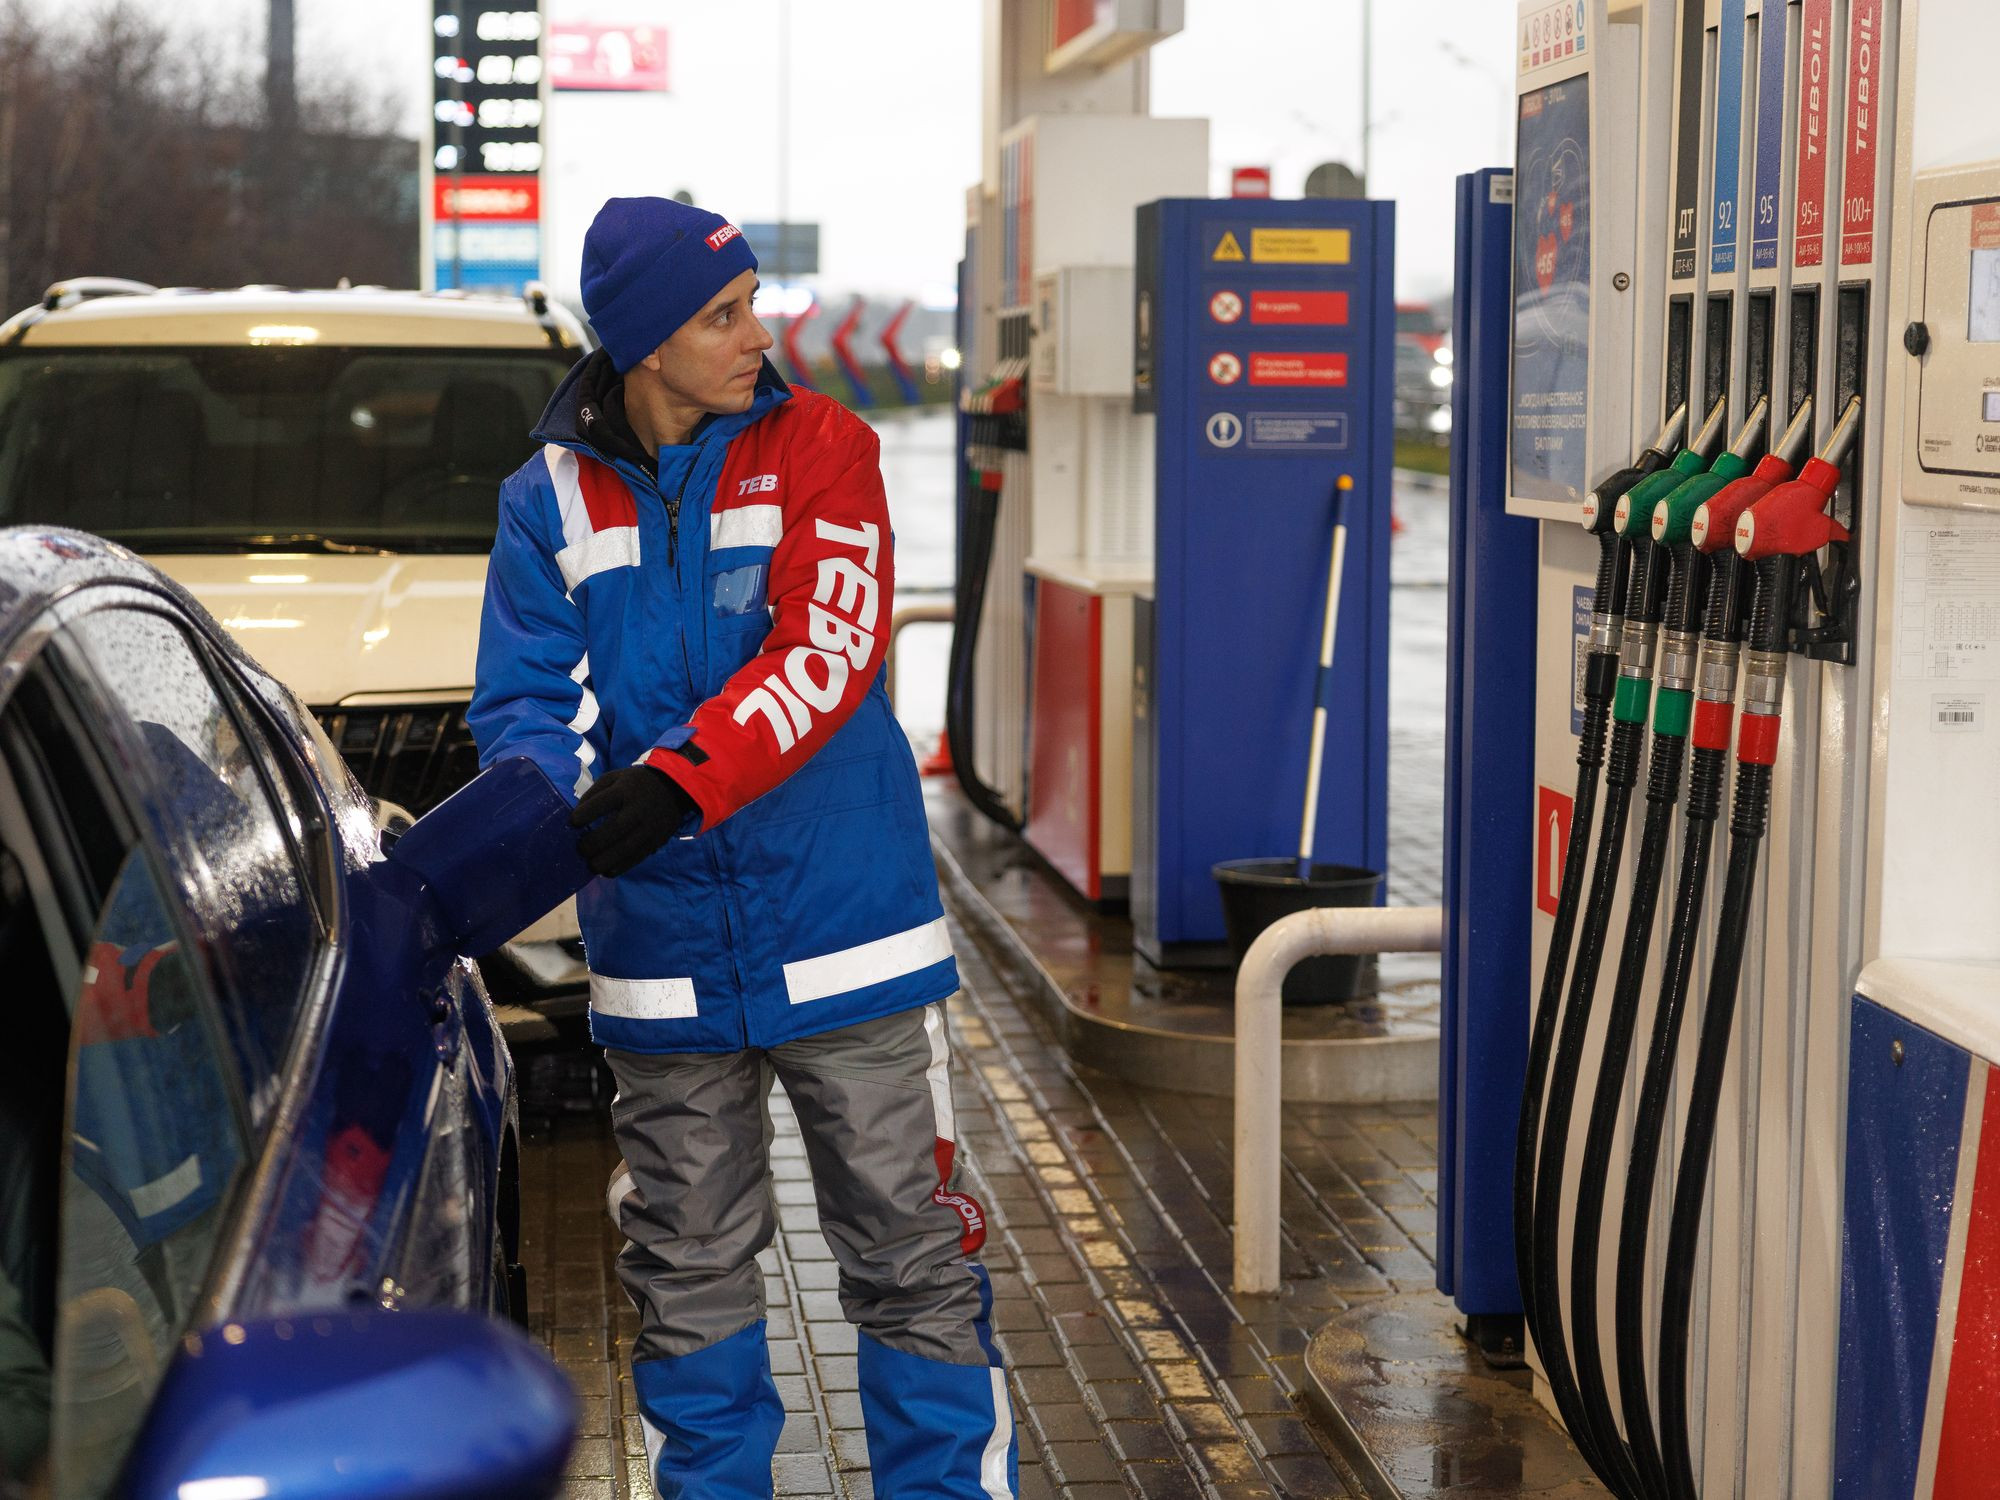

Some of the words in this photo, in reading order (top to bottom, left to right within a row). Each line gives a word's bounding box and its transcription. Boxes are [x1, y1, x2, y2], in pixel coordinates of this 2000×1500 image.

[1807, 17, 1824, 160] TEBOIL
[1855, 6, 1873, 155] TEBOIL
[1678, 208, 1694, 239] ДТ
[1718, 200, 1732, 229] 92
[1760, 194, 1774, 224] 95
[1801, 200, 1819, 225] 95+
[1846, 196, 1872, 222] 100+
[732, 518, 879, 755] TEBOIL
